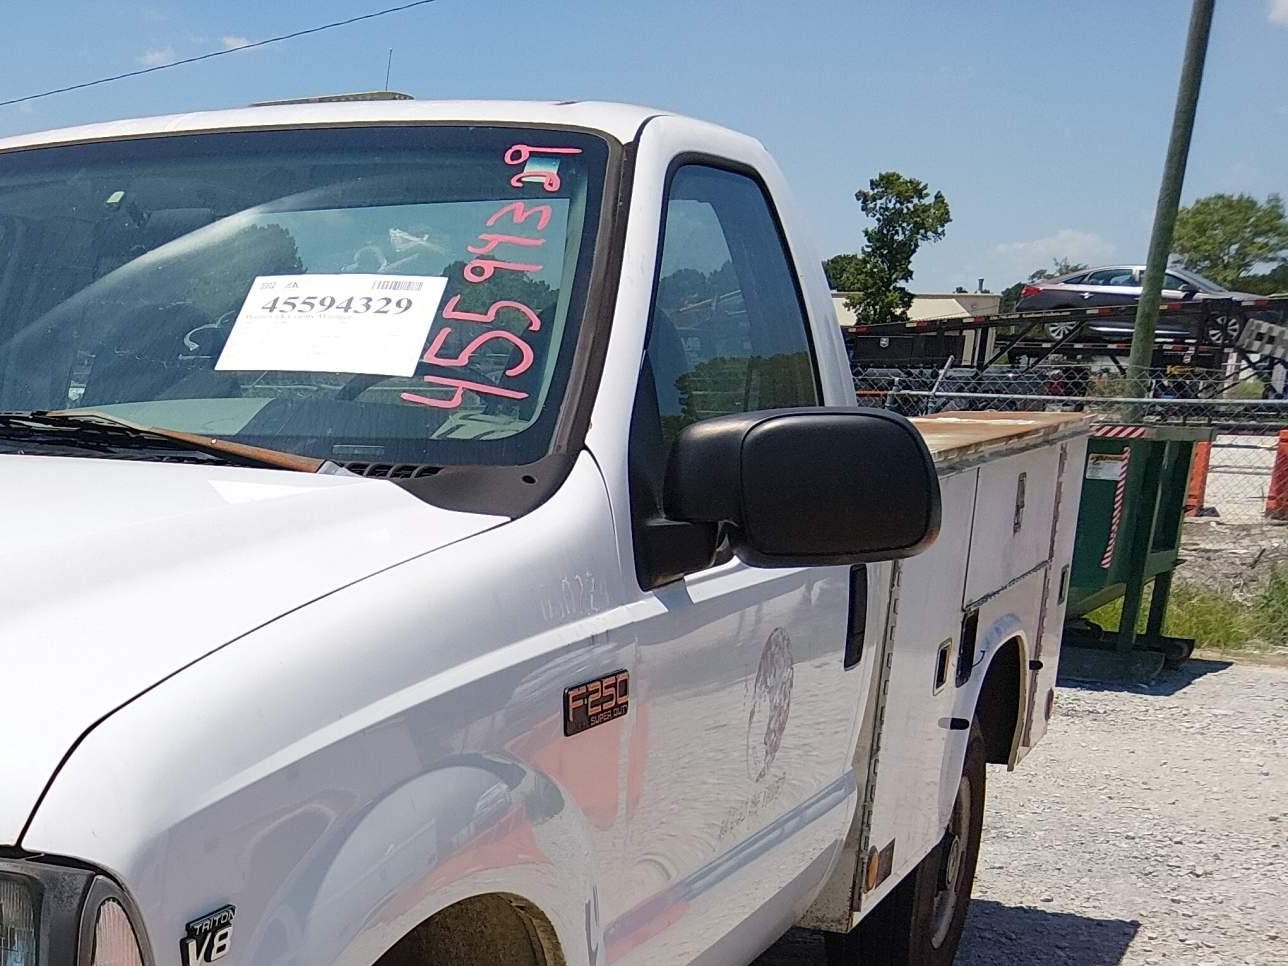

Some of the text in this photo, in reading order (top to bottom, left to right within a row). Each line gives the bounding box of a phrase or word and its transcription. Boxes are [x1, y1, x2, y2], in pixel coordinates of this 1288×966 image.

[261, 295, 413, 315] 45594329
[591, 711, 612, 726] SUPER
[194, 909, 234, 935] TRITON
